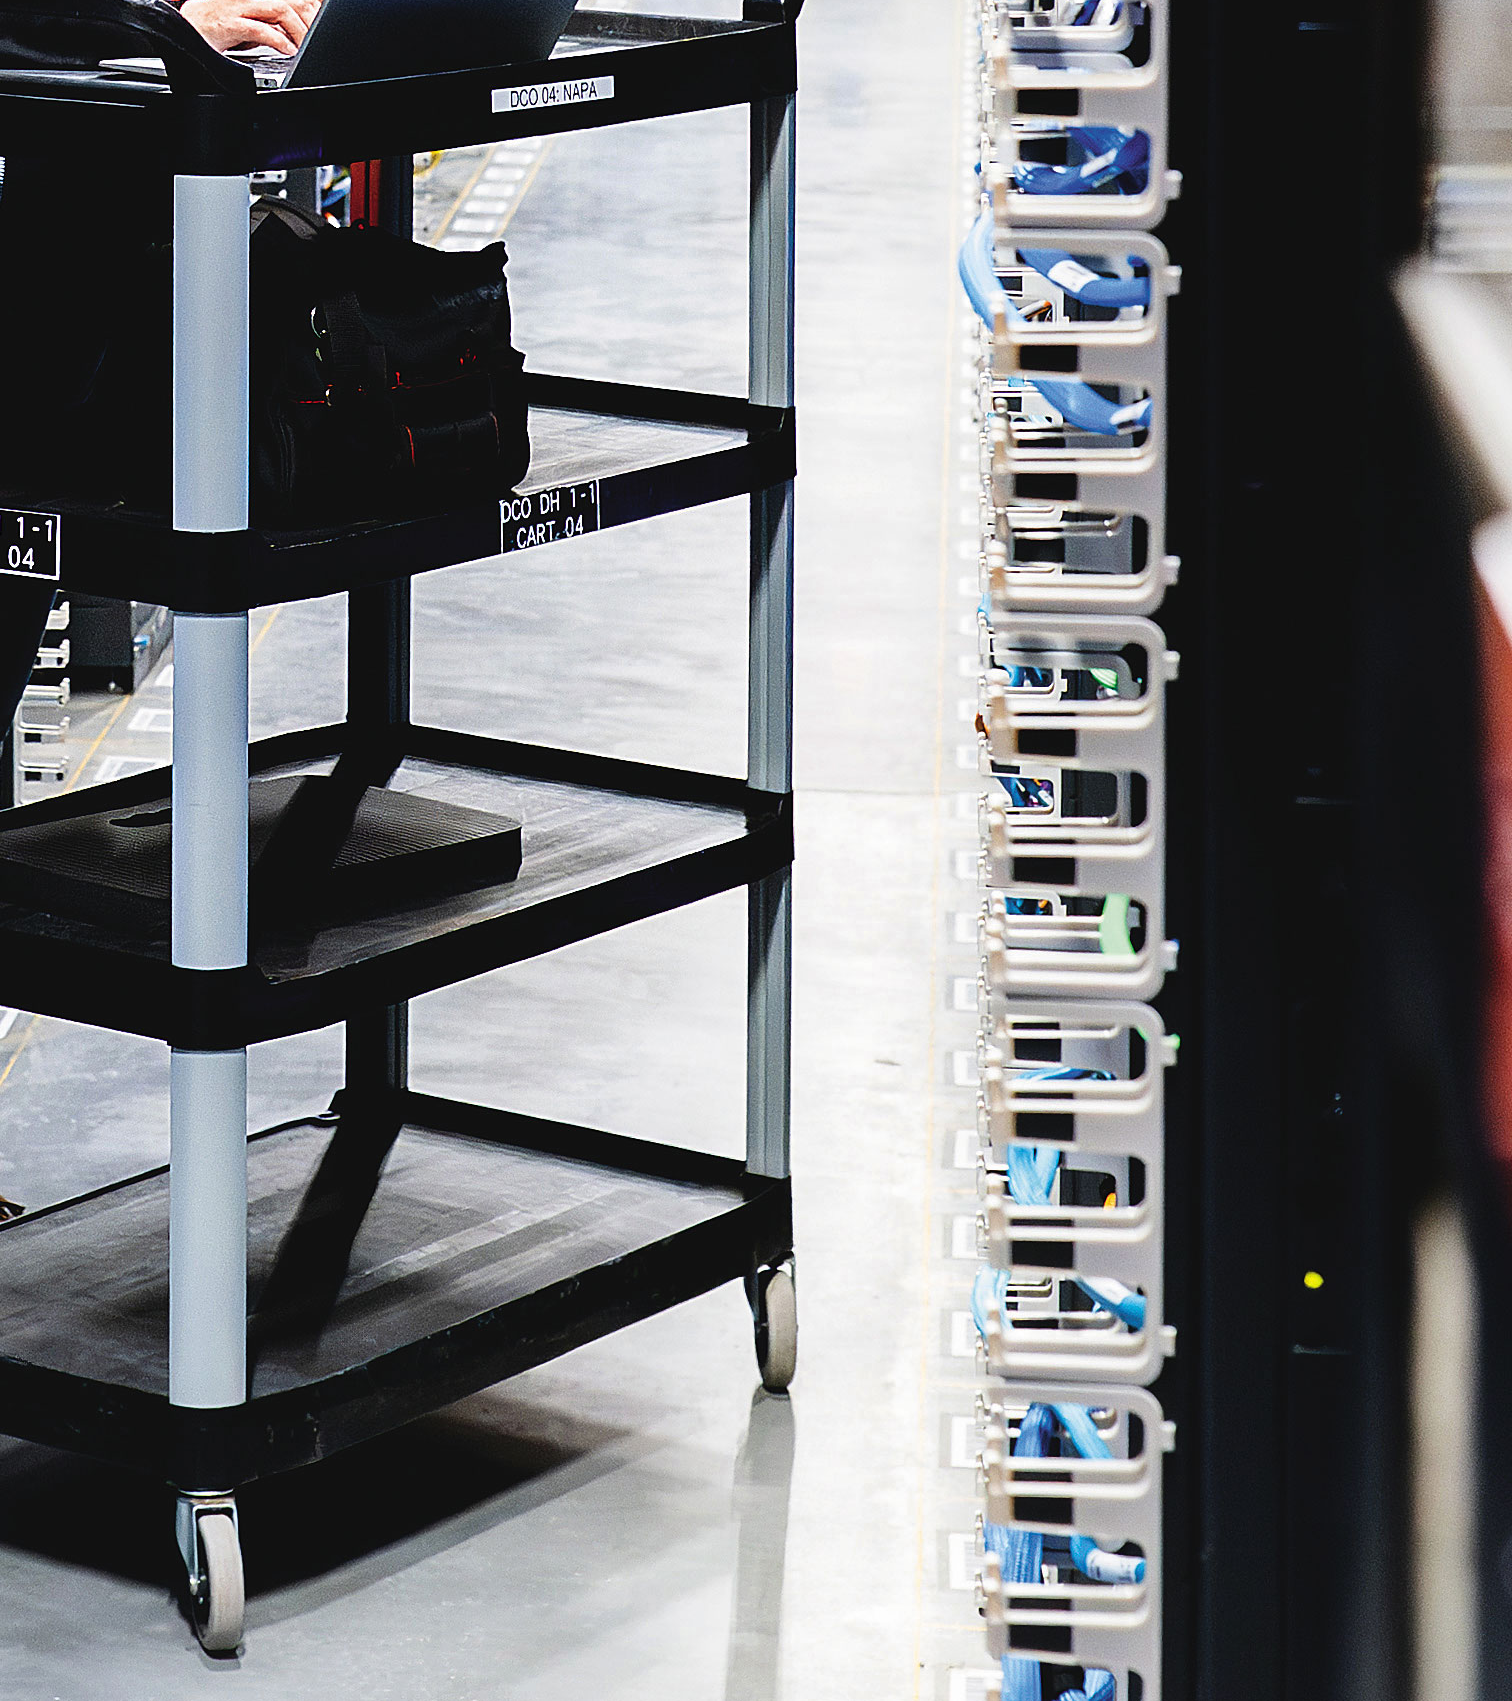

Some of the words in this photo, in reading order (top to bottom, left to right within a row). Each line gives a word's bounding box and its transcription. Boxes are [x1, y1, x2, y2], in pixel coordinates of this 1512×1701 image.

[510, 88, 539, 108] DCO
[542, 86, 560, 104] 04:
[563, 81, 597, 101] NAPA
[501, 497, 532, 524] DCO
[540, 490, 560, 515] DH
[570, 483, 595, 508] 1-1
[16, 516, 53, 542] 1-1
[516, 520, 556, 548] CART
[565, 514, 584, 537] 04
[8, 545, 35, 570] 04
